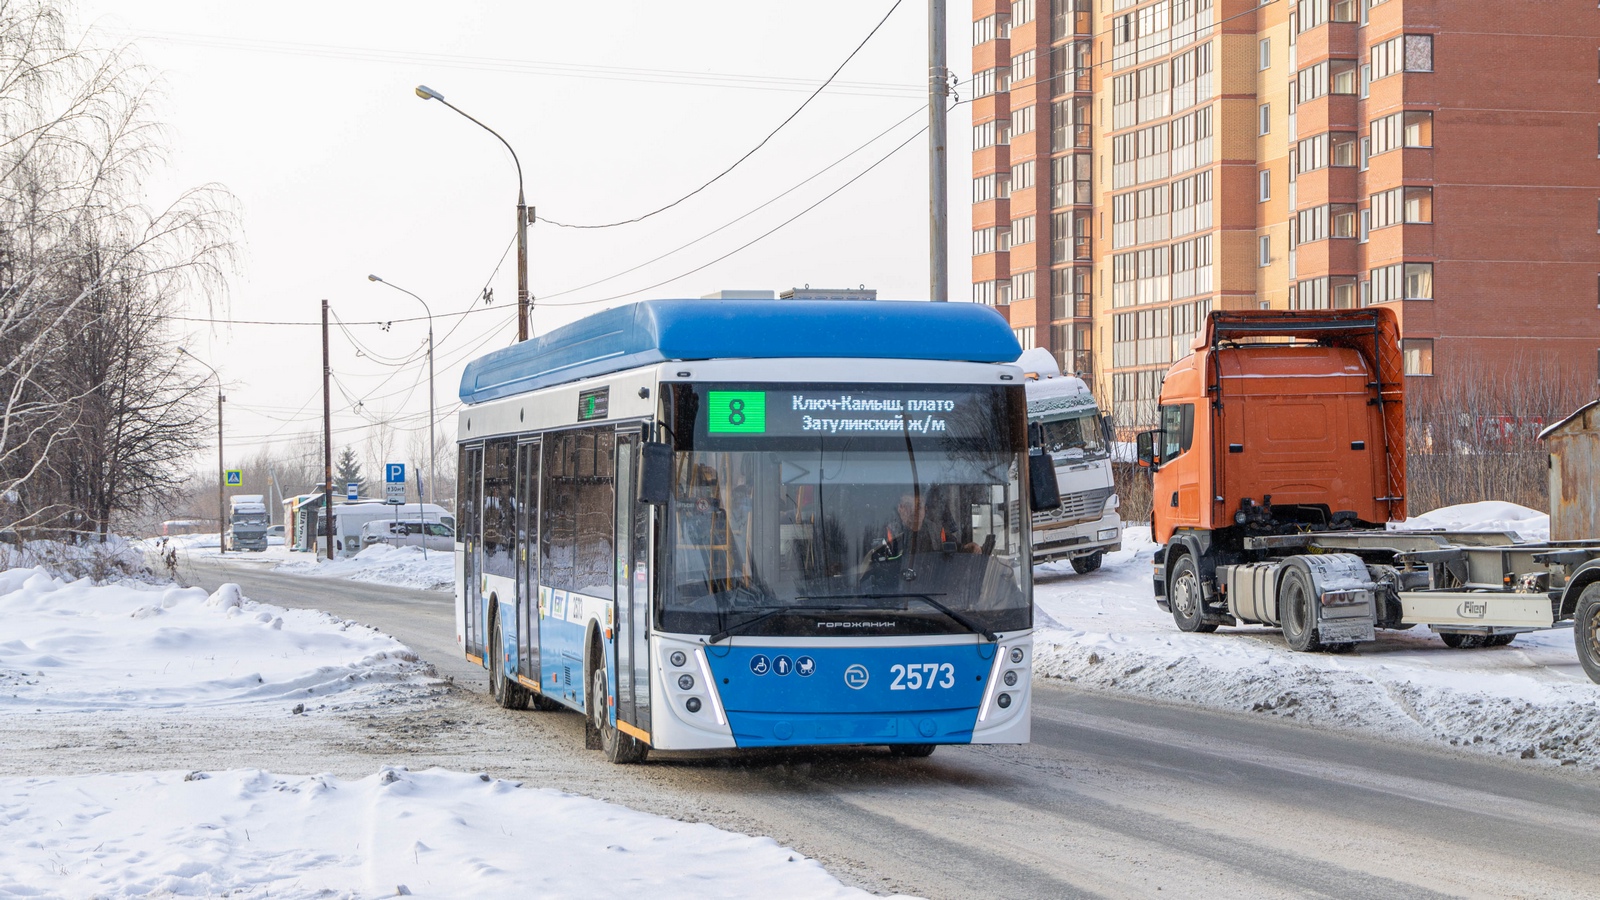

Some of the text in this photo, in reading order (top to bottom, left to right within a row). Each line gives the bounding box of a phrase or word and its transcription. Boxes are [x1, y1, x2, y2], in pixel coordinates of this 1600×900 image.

[792, 394, 955, 411] Ключ-Камыш. плато
[729, 398, 746, 426] 8
[802, 414, 946, 434] Затулинский ж/м
[391, 465, 402, 481] P
[391, 485, 402, 493] 30м
[1463, 600, 1488, 617] Fliegl
[890, 662, 955, 690] 2573
